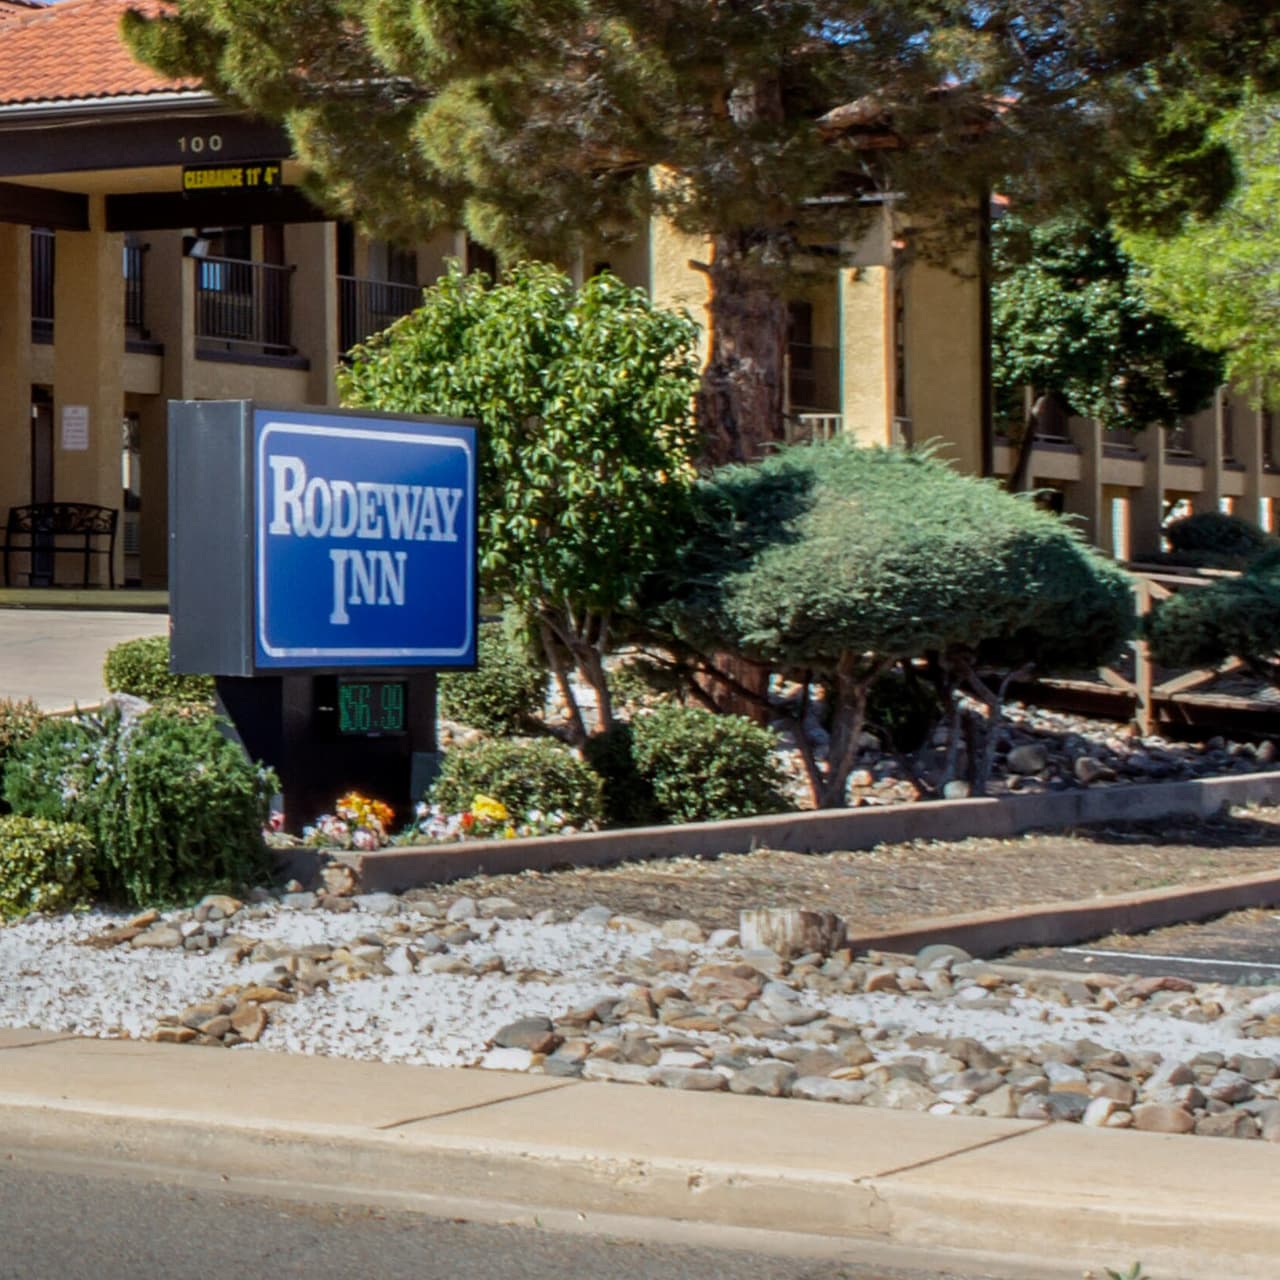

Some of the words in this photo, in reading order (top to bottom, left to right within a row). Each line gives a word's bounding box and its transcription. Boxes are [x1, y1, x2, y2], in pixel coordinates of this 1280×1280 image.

[177, 135, 223, 152] 100
[268, 454, 464, 543] RODEWAY
[329, 550, 408, 625] INN
